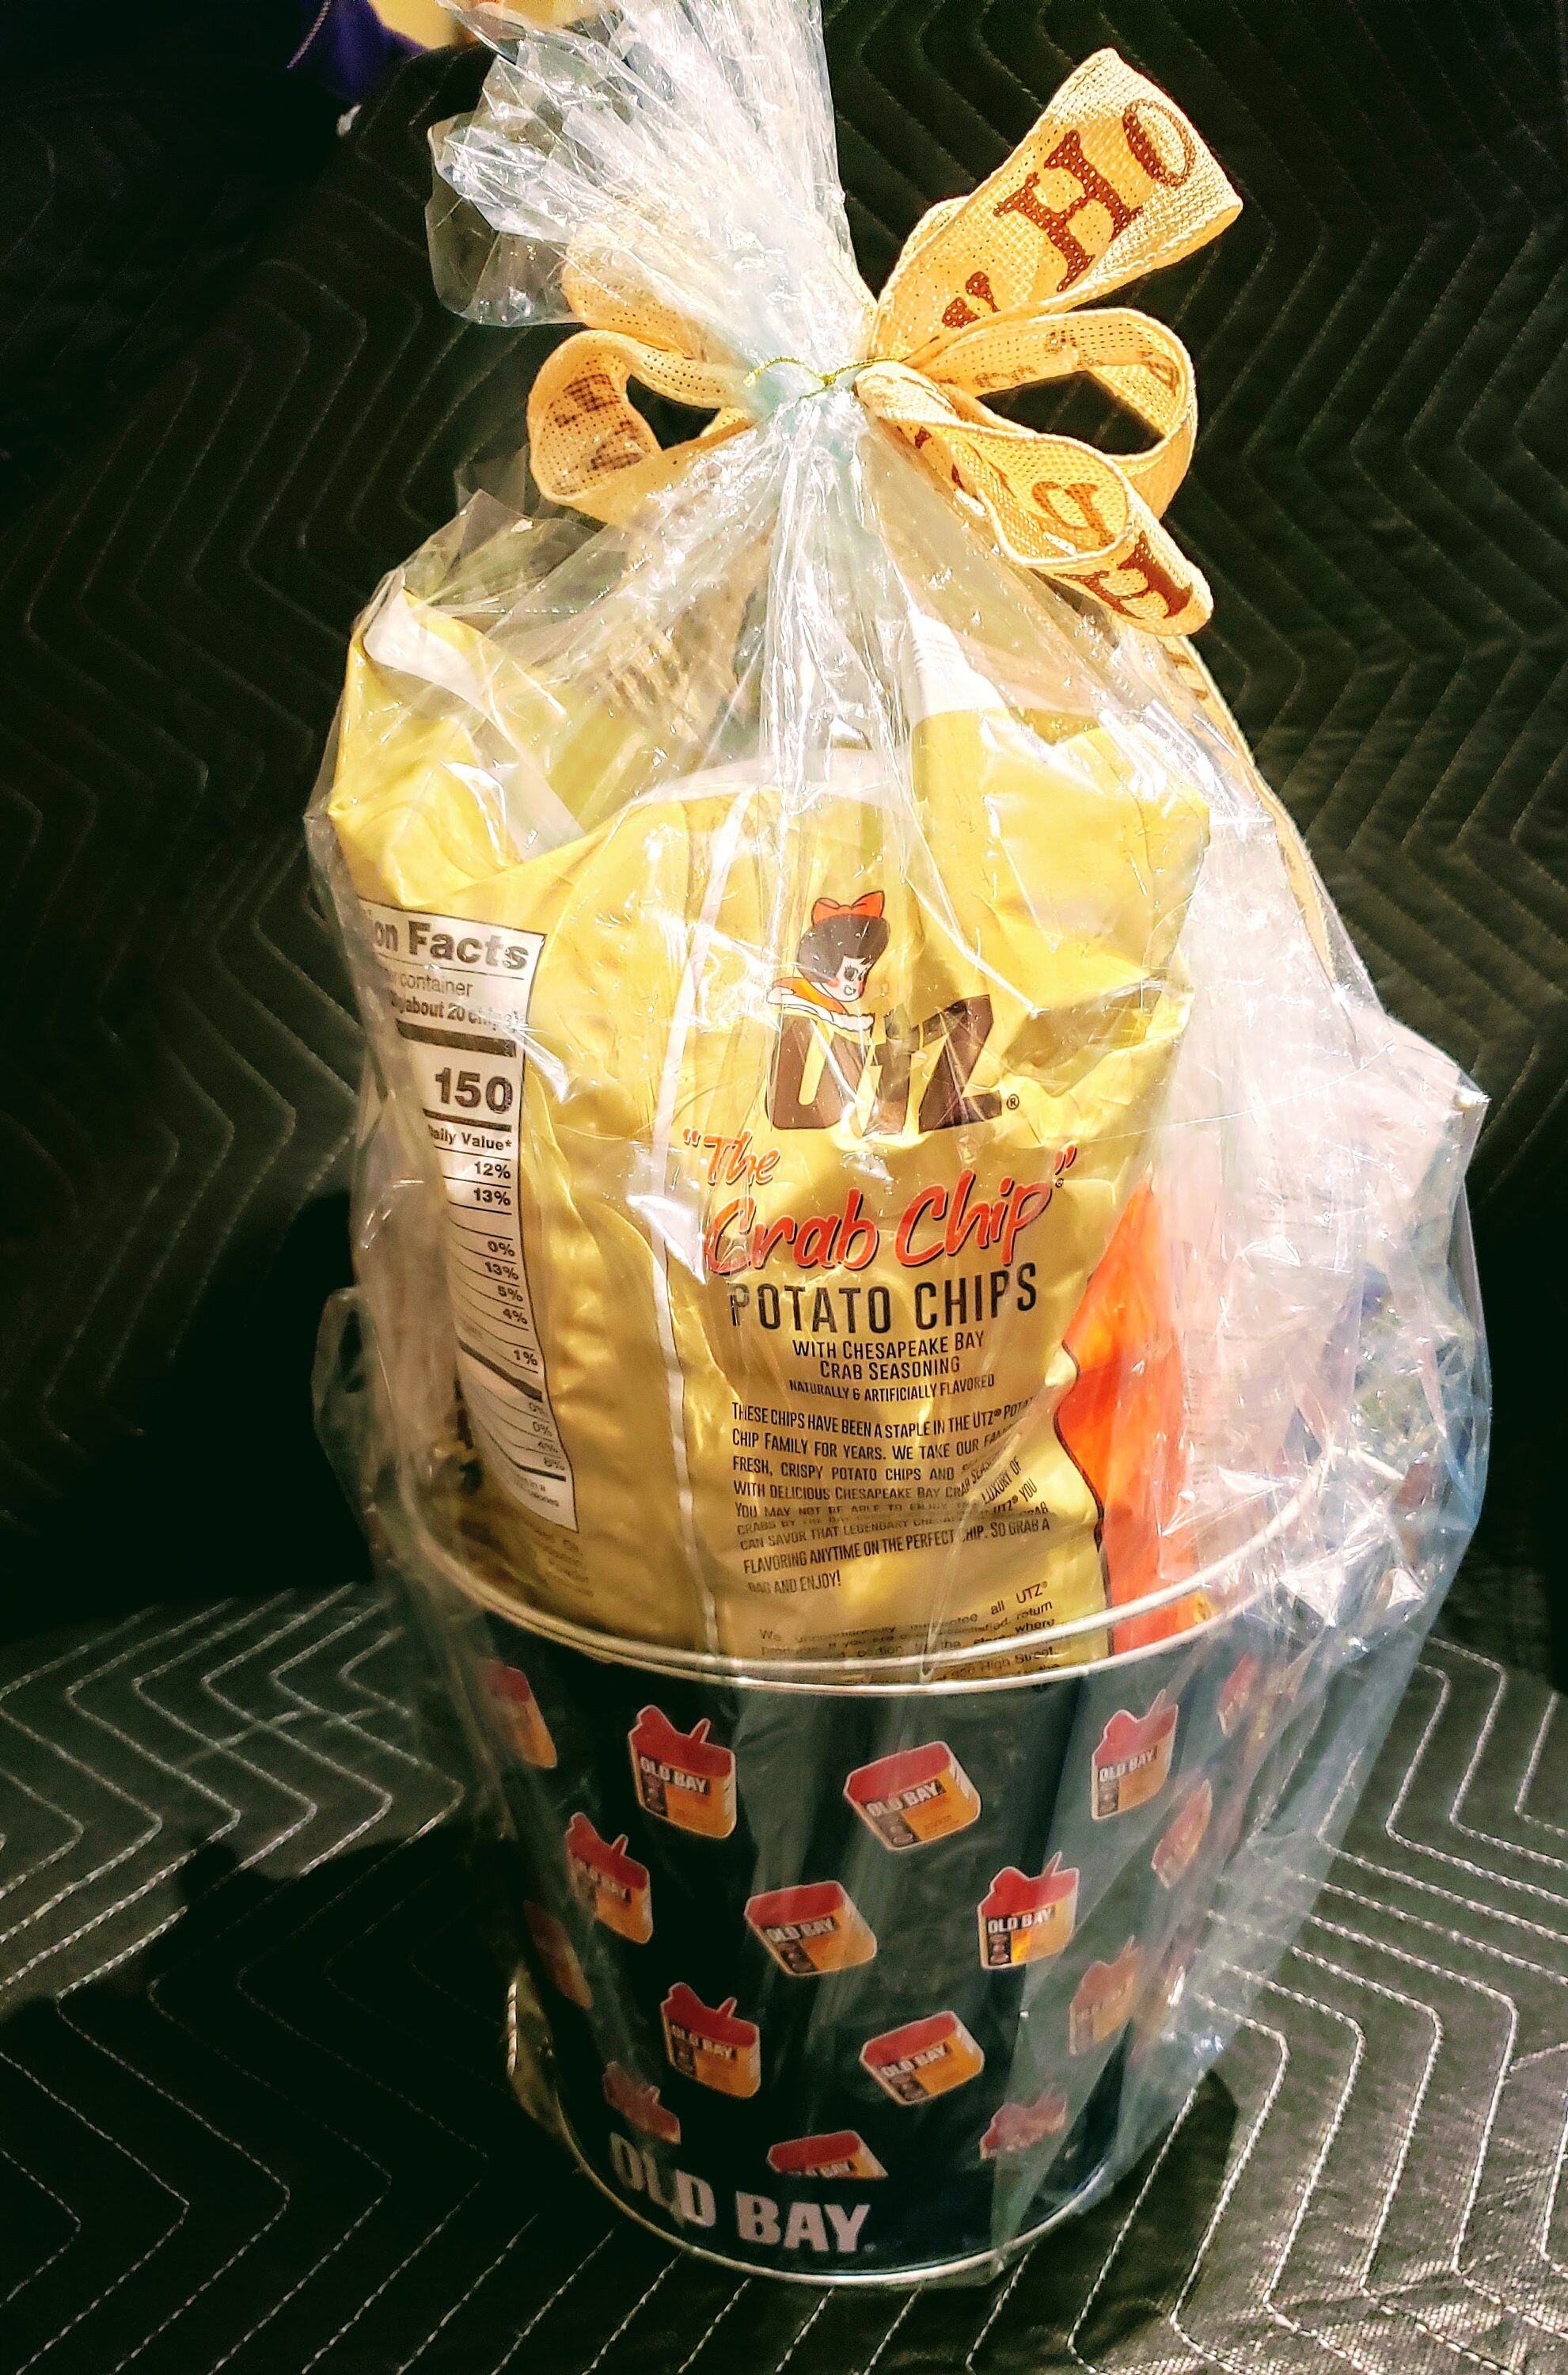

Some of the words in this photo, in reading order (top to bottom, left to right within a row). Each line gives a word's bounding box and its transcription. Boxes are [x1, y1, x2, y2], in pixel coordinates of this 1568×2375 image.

[408, 920, 530, 971] Facts
[401, 973, 473, 997] container
[446, 1001, 465, 1022] 20
[435, 1066, 513, 1115] 150
[474, 1161, 511, 1180] 12%
[473, 1188, 511, 1206] 13%
[704, 1188, 880, 1274] Crab
[487, 1240, 515, 1257] 0%
[484, 1261, 518, 1280] 13%
[497, 1285, 523, 1302] 5%
[730, 1282, 891, 1335] POTATO
[914, 1262, 1037, 1329] CHIPS
[503, 1308, 528, 1325] 4%
[792, 1339, 837, 1359] WITH
[842, 1336, 948, 1360] CHESAPEAKE
[955, 1330, 985, 1351] BAY
[513, 1350, 538, 1366] 1%
[820, 1360, 862, 1381] CRAB
[869, 1355, 960, 1381] SEASONING
[789, 1379, 849, 1400] NATURALLY
[852, 1388, 860, 1400] &
[864, 1383, 937, 1402] ARTIFICIALLY
[940, 1374, 995, 1396] FLAVORED
[731, 1402, 769, 1424] THESE
[771, 1409, 805, 1429] CHIPS
[807, 1414, 839, 1434] HAVE
[841, 1418, 871, 1438] BEEN
[874, 1423, 883, 1438] A
[885, 1420, 931, 1438] STAPLE
[933, 1419, 945, 1435] IN
[948, 1414, 970, 1433] THE
[732, 1428, 759, 1448] CHIP
[765, 1432, 808, 1455] FAMILY
[814, 1441, 837, 1457] FOR
[843, 1445, 887, 1461] YEARS.
[892, 1445, 913, 1460] WE
[921, 1443, 950, 1460] TAKE
[956, 1438, 979, 1457] OUR
[733, 1456, 773, 1476] FRESH,
[781, 1462, 823, 1480] CRISPY
[832, 1467, 877, 1481] POTATO
[886, 1468, 921, 1481] CHIPS
[930, 1467, 955, 1480] AND
[981, 1469, 1012, 1505] LUXURY
[1009, 1455, 1022, 1476] OF
[734, 1480, 765, 1497] WITH
[770, 1484, 830, 1500] DELICIOUS
[835, 1487, 911, 1500] CHESAPEAKE
[917, 1487, 940, 1499] BAY
[1019, 1477, 1038, 1503] YOU
[735, 1502, 757, 1518] YOU
[765, 1507, 791, 1517] MAY
[799, 1506, 821, 1515] NOT
[737, 1520, 776, 1535] CRABS
[740, 1538, 765, 1550] CAN
[769, 1530, 807, 1546] SAVOR
[811, 1526, 838, 1540] THAT
[743, 1551, 807, 1574] FLAVORING
[810, 1541, 861, 1564] ANYTIME
[864, 1540, 879, 1556] ON
[883, 1537, 903, 1553] THE
[906, 1529, 955, 1550] PERFECT
[962, 1526, 988, 1543] HIP.
[991, 1522, 1006, 1537] SO
[1009, 1519, 1040, 1536] GRAB
[1042, 1518, 1050, 1530] A
[774, 1578, 797, 1594] AND
[799, 1569, 841, 1591] ENJOY!
[990, 1600, 1005, 1615] all
[640, 1757, 670, 1780] OLD
[674, 1771, 706, 1793] BAY
[1099, 1763, 1126, 1782] OLD
[1129, 1747, 1154, 1772] BAY
[902, 1781, 939, 1806] BAY
[988, 1917, 1017, 1933] OLD
[1022, 1907, 1051, 1927] BAY
[610, 2131, 716, 2229] OLD
[736, 2191, 871, 2253] BAY
